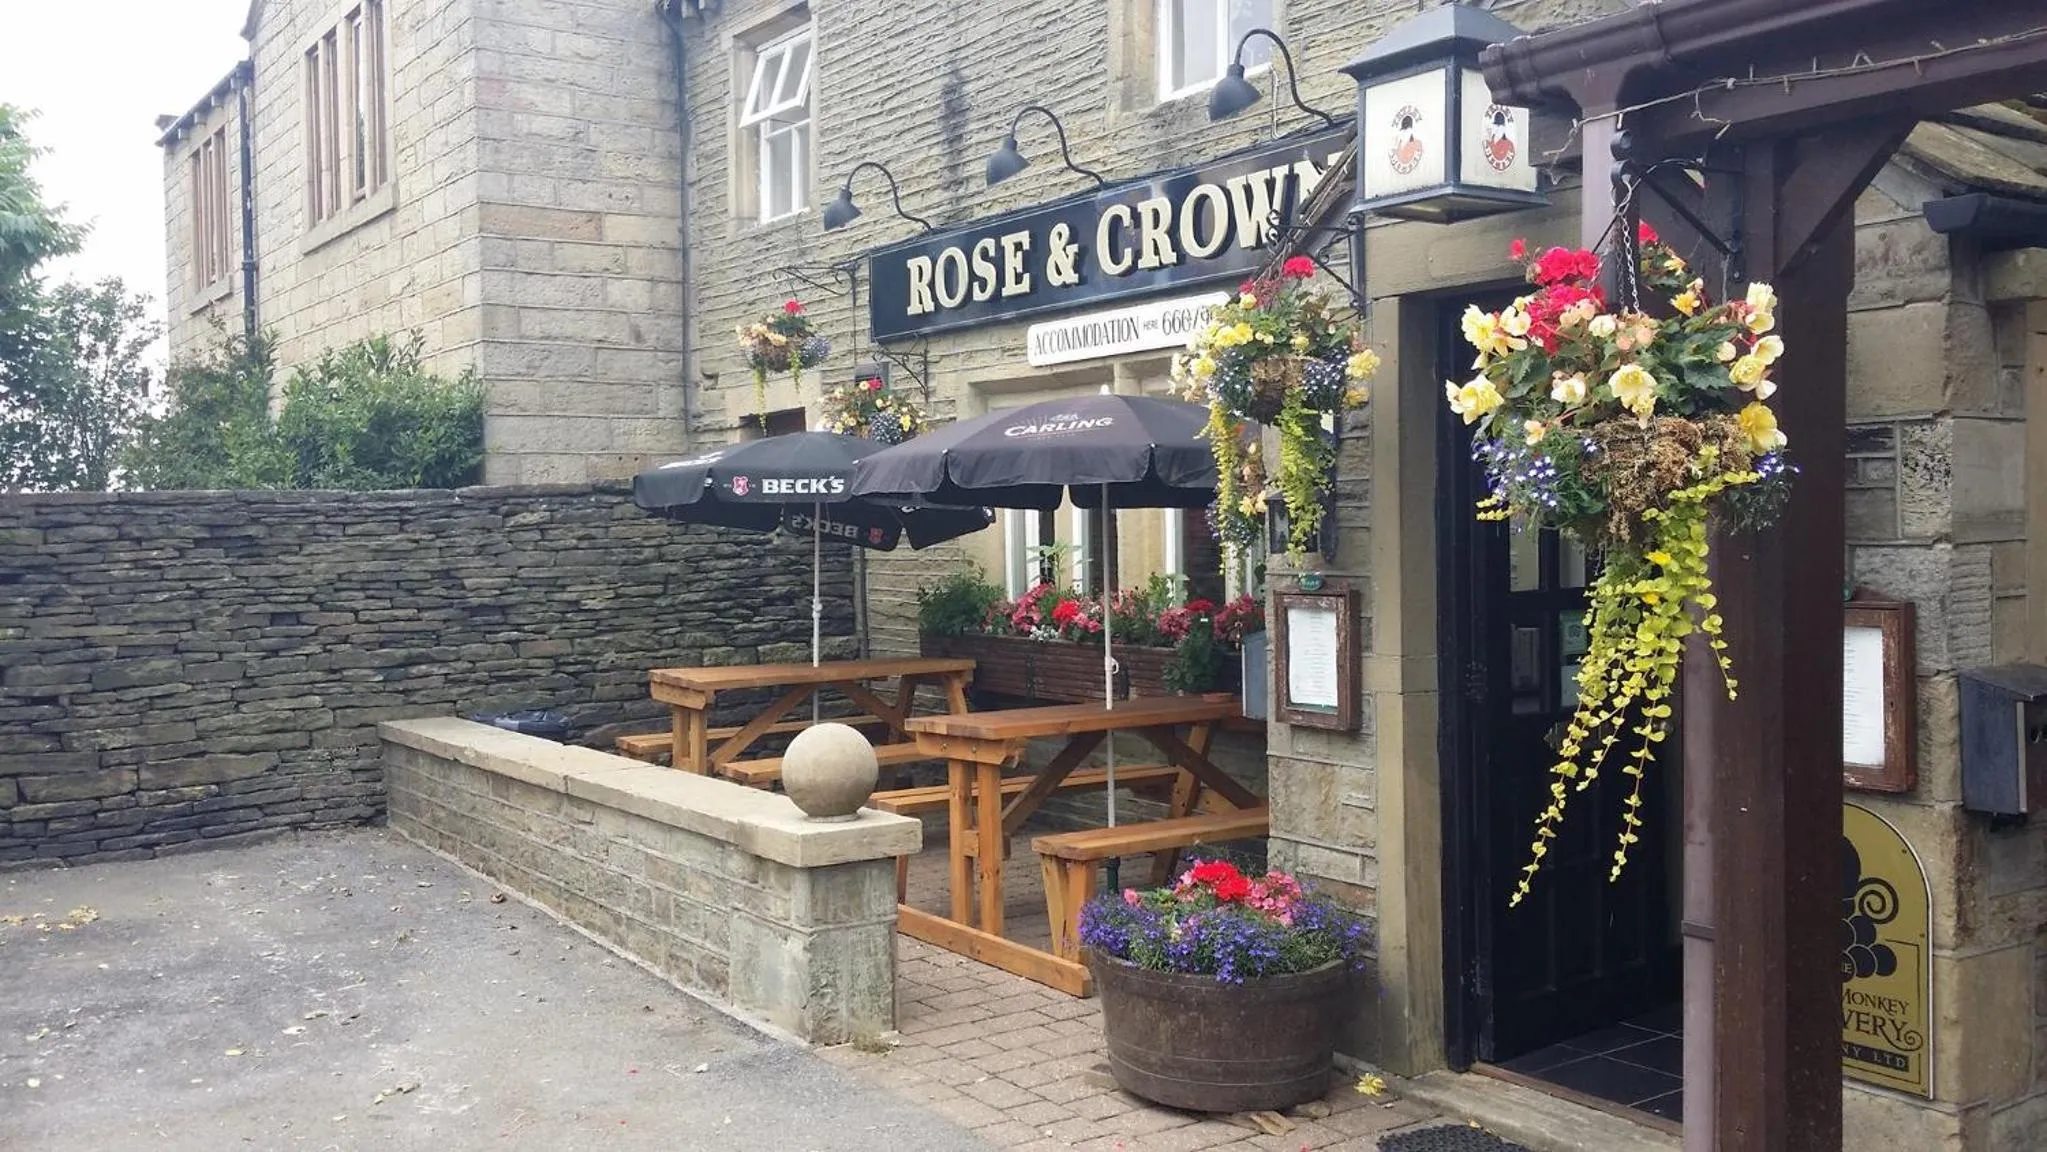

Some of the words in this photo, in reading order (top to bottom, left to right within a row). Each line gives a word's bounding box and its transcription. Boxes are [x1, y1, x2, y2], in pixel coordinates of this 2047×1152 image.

[906, 230, 1031, 316] ROSE
[1046, 222, 1079, 287] &
[1034, 315, 1140, 357] ACCOMMODATION
[1143, 319, 1159, 331] HERE
[1004, 417, 1113, 437] CARLING
[761, 475, 845, 494] BECK'S
[1872, 1051, 1906, 1069] LTD
